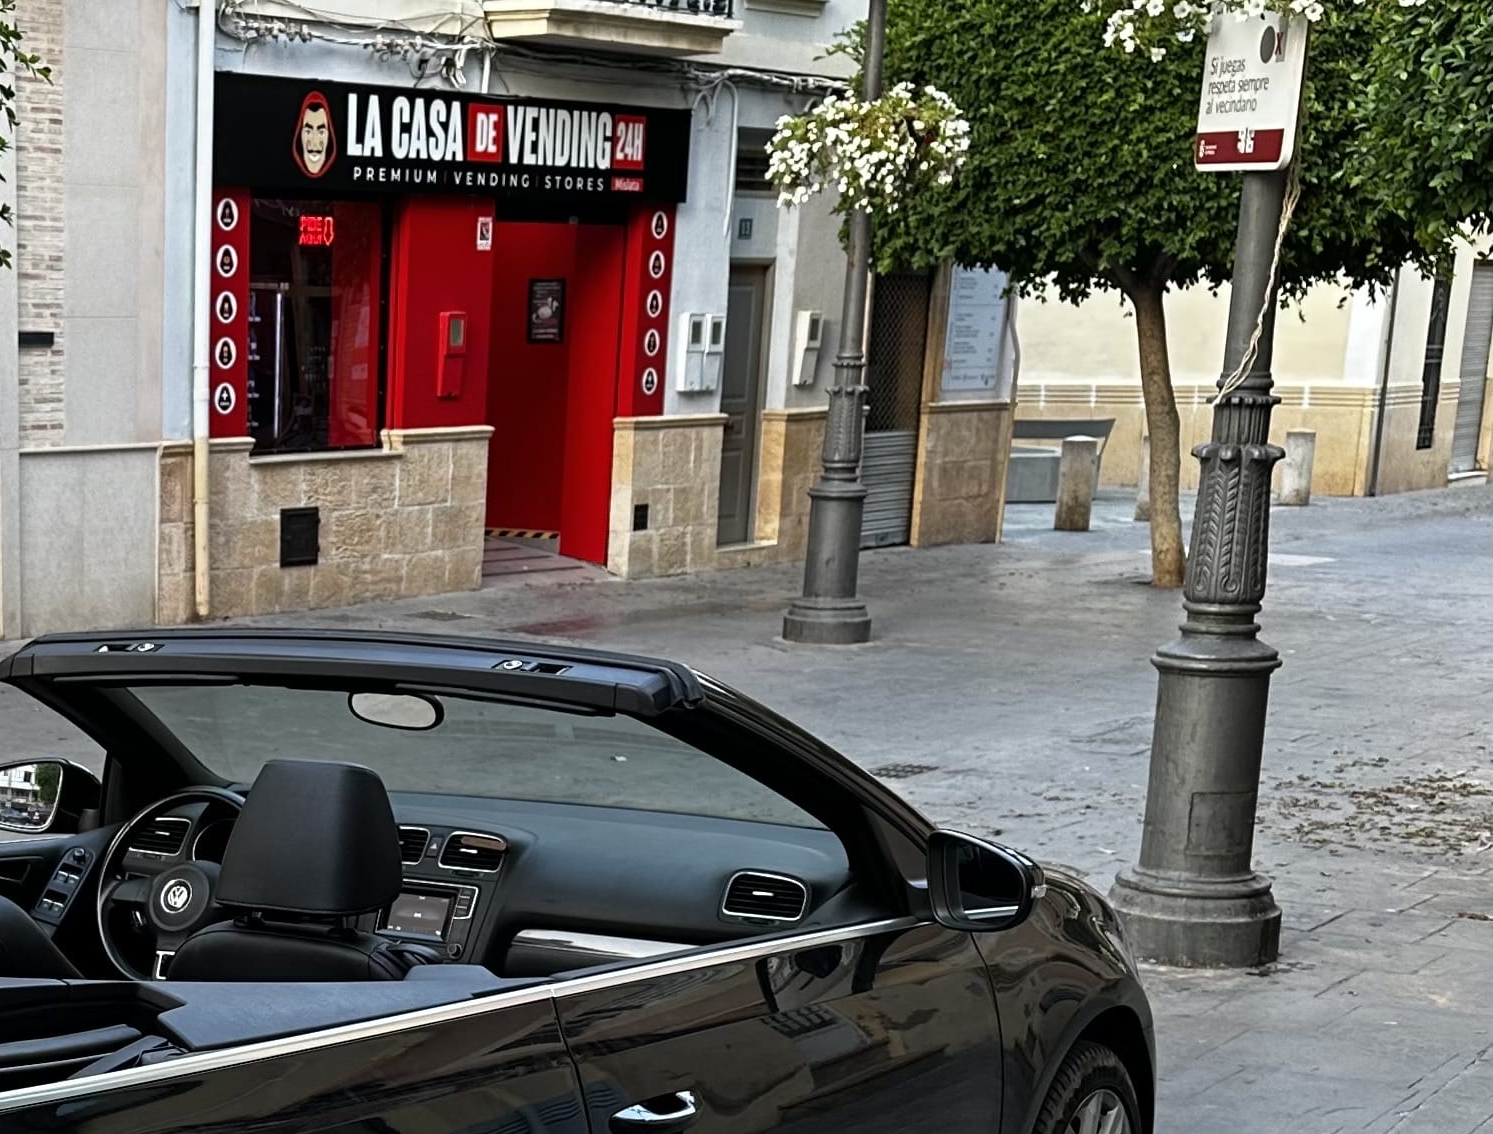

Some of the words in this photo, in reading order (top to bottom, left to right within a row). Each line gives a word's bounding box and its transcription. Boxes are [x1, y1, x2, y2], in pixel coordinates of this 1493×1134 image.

[1210, 56, 1219, 76] Si
[1219, 56, 1246, 78] juegas
[1208, 78, 1236, 97] respeta
[1238, 77, 1270, 95] siempre
[1205, 96, 1214, 115] al
[346, 92, 383, 157] LA
[391, 95, 464, 162] CASA
[475, 112, 499, 153] DE
[507, 104, 613, 170] VENDING
[615, 121, 644, 162] 24H
[353, 166, 437, 184] PREMIUM
[454, 171, 530, 188] VENDING
[544, 175, 604, 192] STORES
